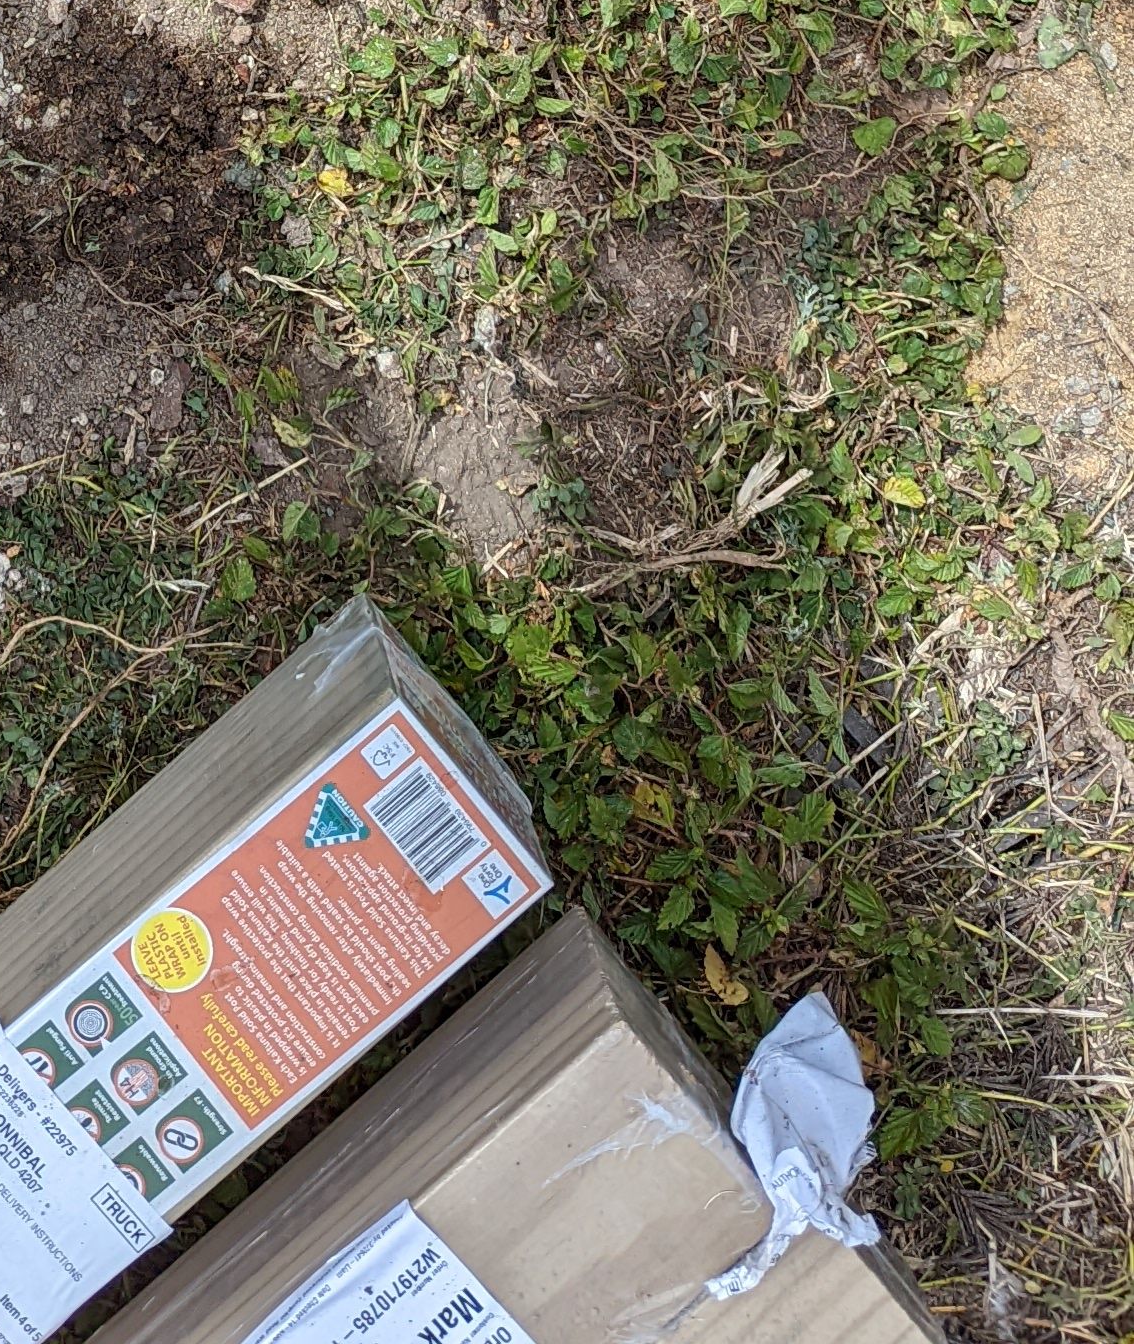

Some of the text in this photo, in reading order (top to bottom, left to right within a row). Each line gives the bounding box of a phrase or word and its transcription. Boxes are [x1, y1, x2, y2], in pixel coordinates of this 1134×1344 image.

[331, 788, 364, 828] CAUTION
[480, 840, 488, 848] 0
[321, 850, 349, 882] treated
[477, 872, 492, 889] One
[479, 862, 500, 884] Forty
[489, 862, 503, 879] One
[346, 880, 356, 891] is
[352, 887, 370, 909] Post
[275, 839, 392, 982] post should be sealed with a suitable
[352, 852, 444, 963] providing protection against
[365, 906, 387, 929] Solid
[377, 862, 451, 955] decay and insect attack.
[377, 903, 414, 945] in-ground
[154, 922, 187, 980] WRAP ON
[170, 931, 191, 960] until
[176, 914, 207, 967] installed
[231, 869, 361, 1033] Post is ready for finishing. This will ensure
[277, 860, 393, 1006] Immediately after removing the wrap
[337, 895, 412, 989] sealing agent or primer.
[384, 927, 412, 961] Kaituna
[410, 943, 424, 958] for
[137, 941, 162, 982] LEAVE
[145, 931, 175, 980] PLASTIC
[221, 896, 341, 1049] It is important that the protective wrap
[228, 889, 351, 1040] remains in place until the Kaituna Solid
[259, 885, 370, 1024] each post is kept dry and remains in
[318, 942, 351, 980] condition
[409, 958, 425, 979] This
[420, 956, 434, 971] H4
[98, 983, 139, 1027] 50 CCA
[102, 975, 129, 1008] Treatment
[250, 988, 287, 1028] protected
[270, 993, 289, 1011] and
[348, 979, 381, 1016] premium
[45, 1026, 79, 1066] Anti Fungal
[200, 993, 284, 1098] Please read carefully
[224, 991, 298, 1085] Each Kaituna Solid Post
[234, 985, 308, 1077] is wrapped in plastic to
[282, 1026, 296, 1042] it's
[285, 1010, 326, 1059] construction
[145, 1045, 174, 1080] In Ground
[149, 1037, 183, 1078] Applications
[202, 1023, 273, 1108] INFORMATION
[292, 1039, 317, 1068] ensure
[119, 1076, 140, 1099] H4
[201, 1047, 261, 1117] IMPORTANT
[91, 1097, 113, 1124] Termite
[94, 1089, 122, 1122] Resistant
[203, 1105, 228, 1136] Strength
[40, 1116, 78, 1157] #22975
[138, 1144, 169, 1182] Renewable
[17, 1169, 44, 1203] 4207
[100, 1192, 147, 1245] TRUCK
[30, 1222, 83, 1283] INSTRUCTIONS
[317, 1283, 332, 1299] Date
[352, 1247, 442, 1335] W219710785
[411, 1260, 449, 1297] Order Number
[0, 1293, 21, 1320] Item
[18, 1316, 29, 1326] 4
[417, 1288, 484, 1344] Mark
[23, 1323, 38, 1336] of
[31, 1331, 44, 1342] 5
